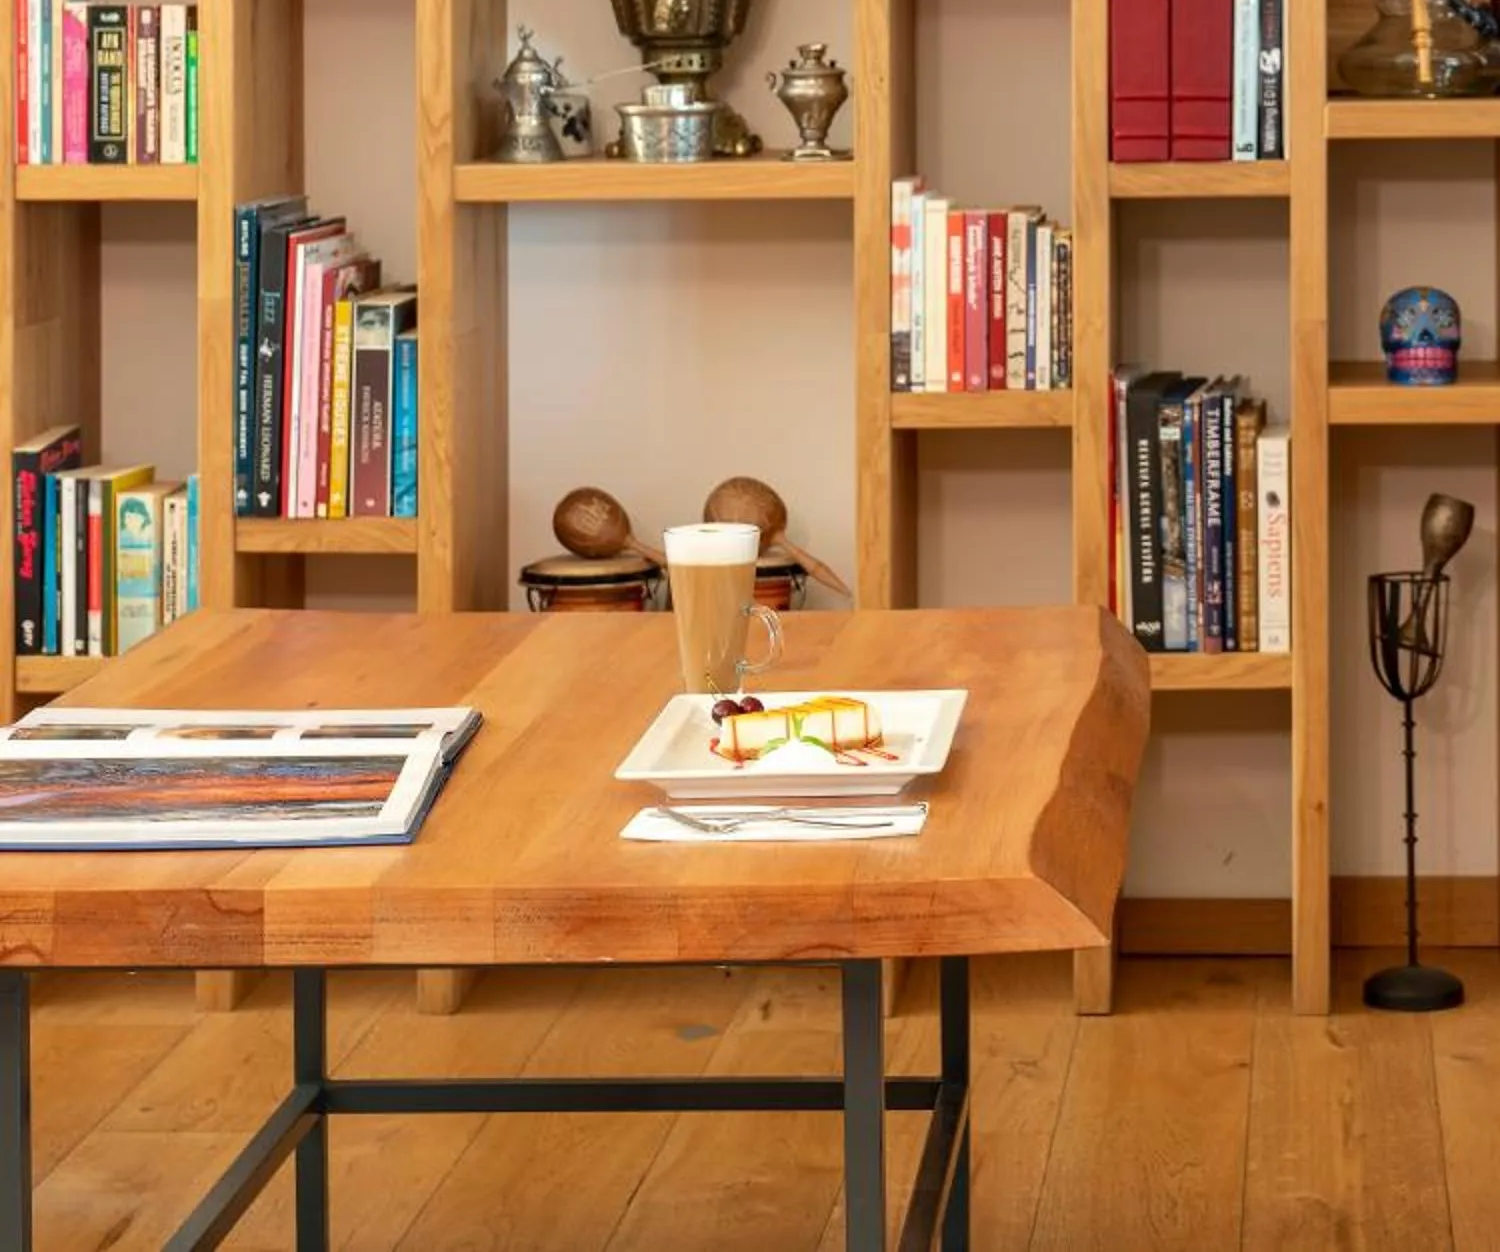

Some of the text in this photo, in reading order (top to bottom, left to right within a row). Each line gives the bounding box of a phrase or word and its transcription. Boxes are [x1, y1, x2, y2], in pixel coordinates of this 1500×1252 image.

[261, 289, 282, 326] Jazz
[260, 374, 274, 481] HERMAN LEONARD
[1207, 407, 1221, 527] TIMBERFRAME
[1260, 512, 1286, 599] Sapiens
